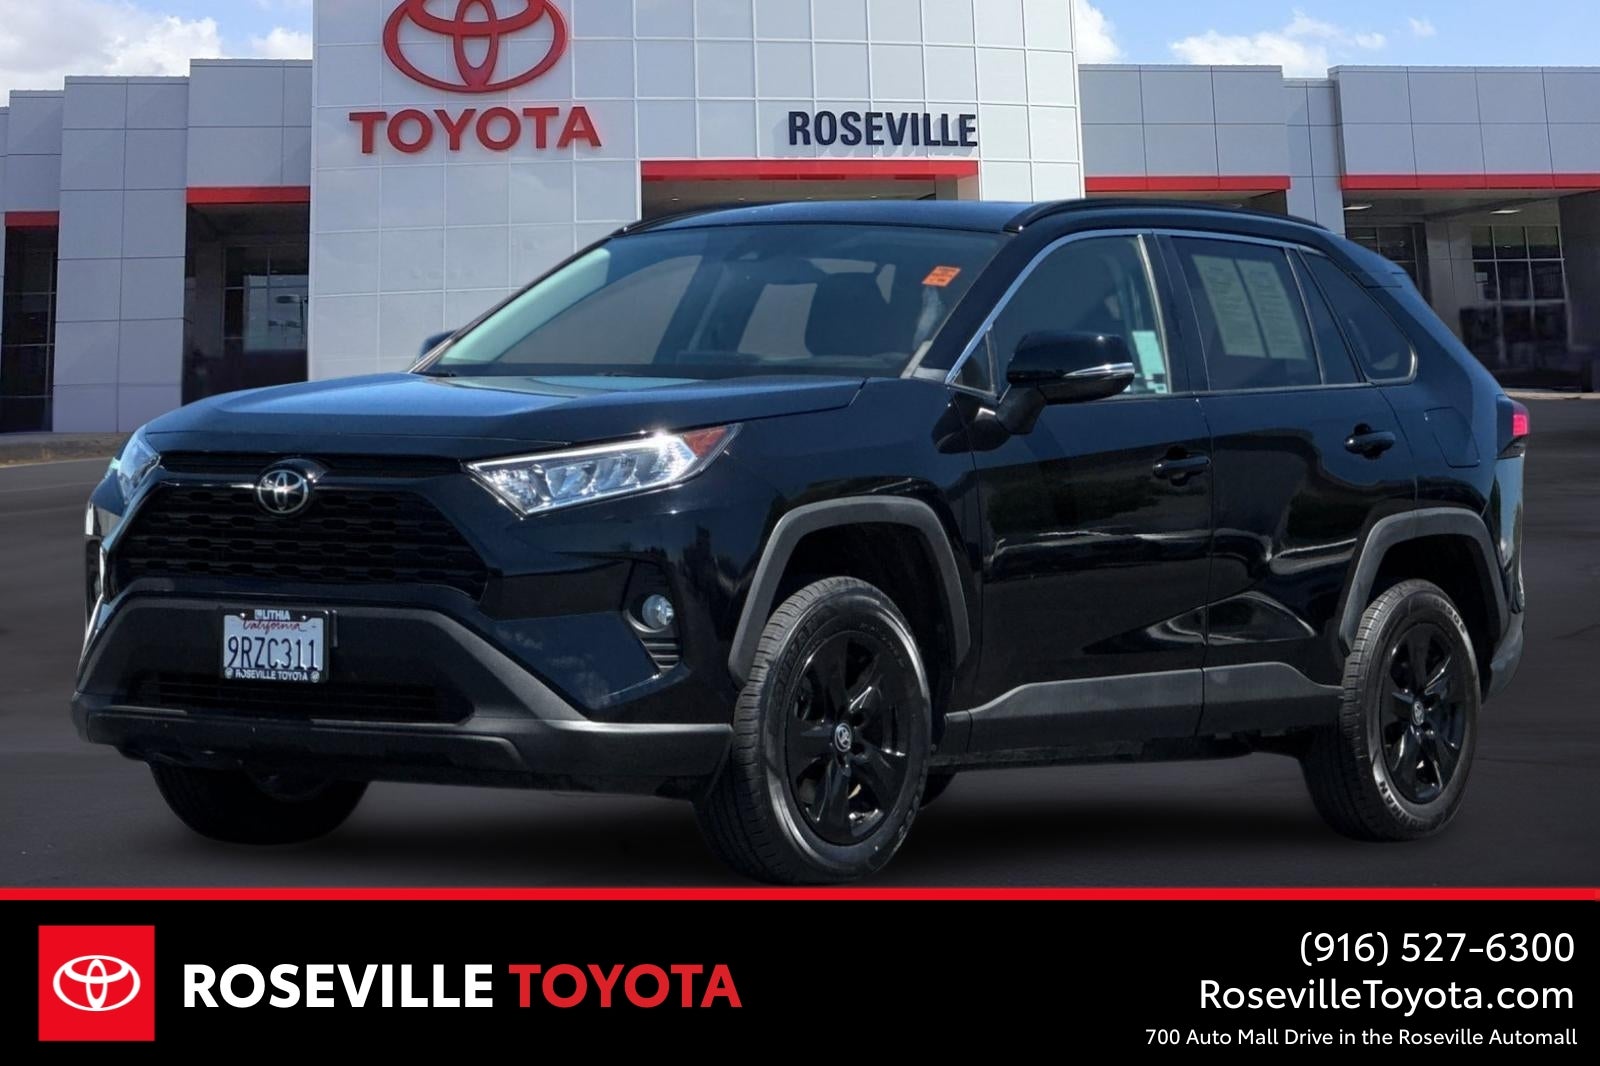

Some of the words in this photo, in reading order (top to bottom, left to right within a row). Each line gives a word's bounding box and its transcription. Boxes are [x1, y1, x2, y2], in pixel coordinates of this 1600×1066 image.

[349, 106, 602, 154] TOYOTA
[788, 110, 978, 147] ROSEVILLE
[242, 619, 301, 635] California
[262, 609, 290, 621] LITHIA
[226, 635, 318, 671] 9RZC311
[235, 669, 276, 680] ROSEVILLE
[278, 671, 308, 681] TOYOTA
